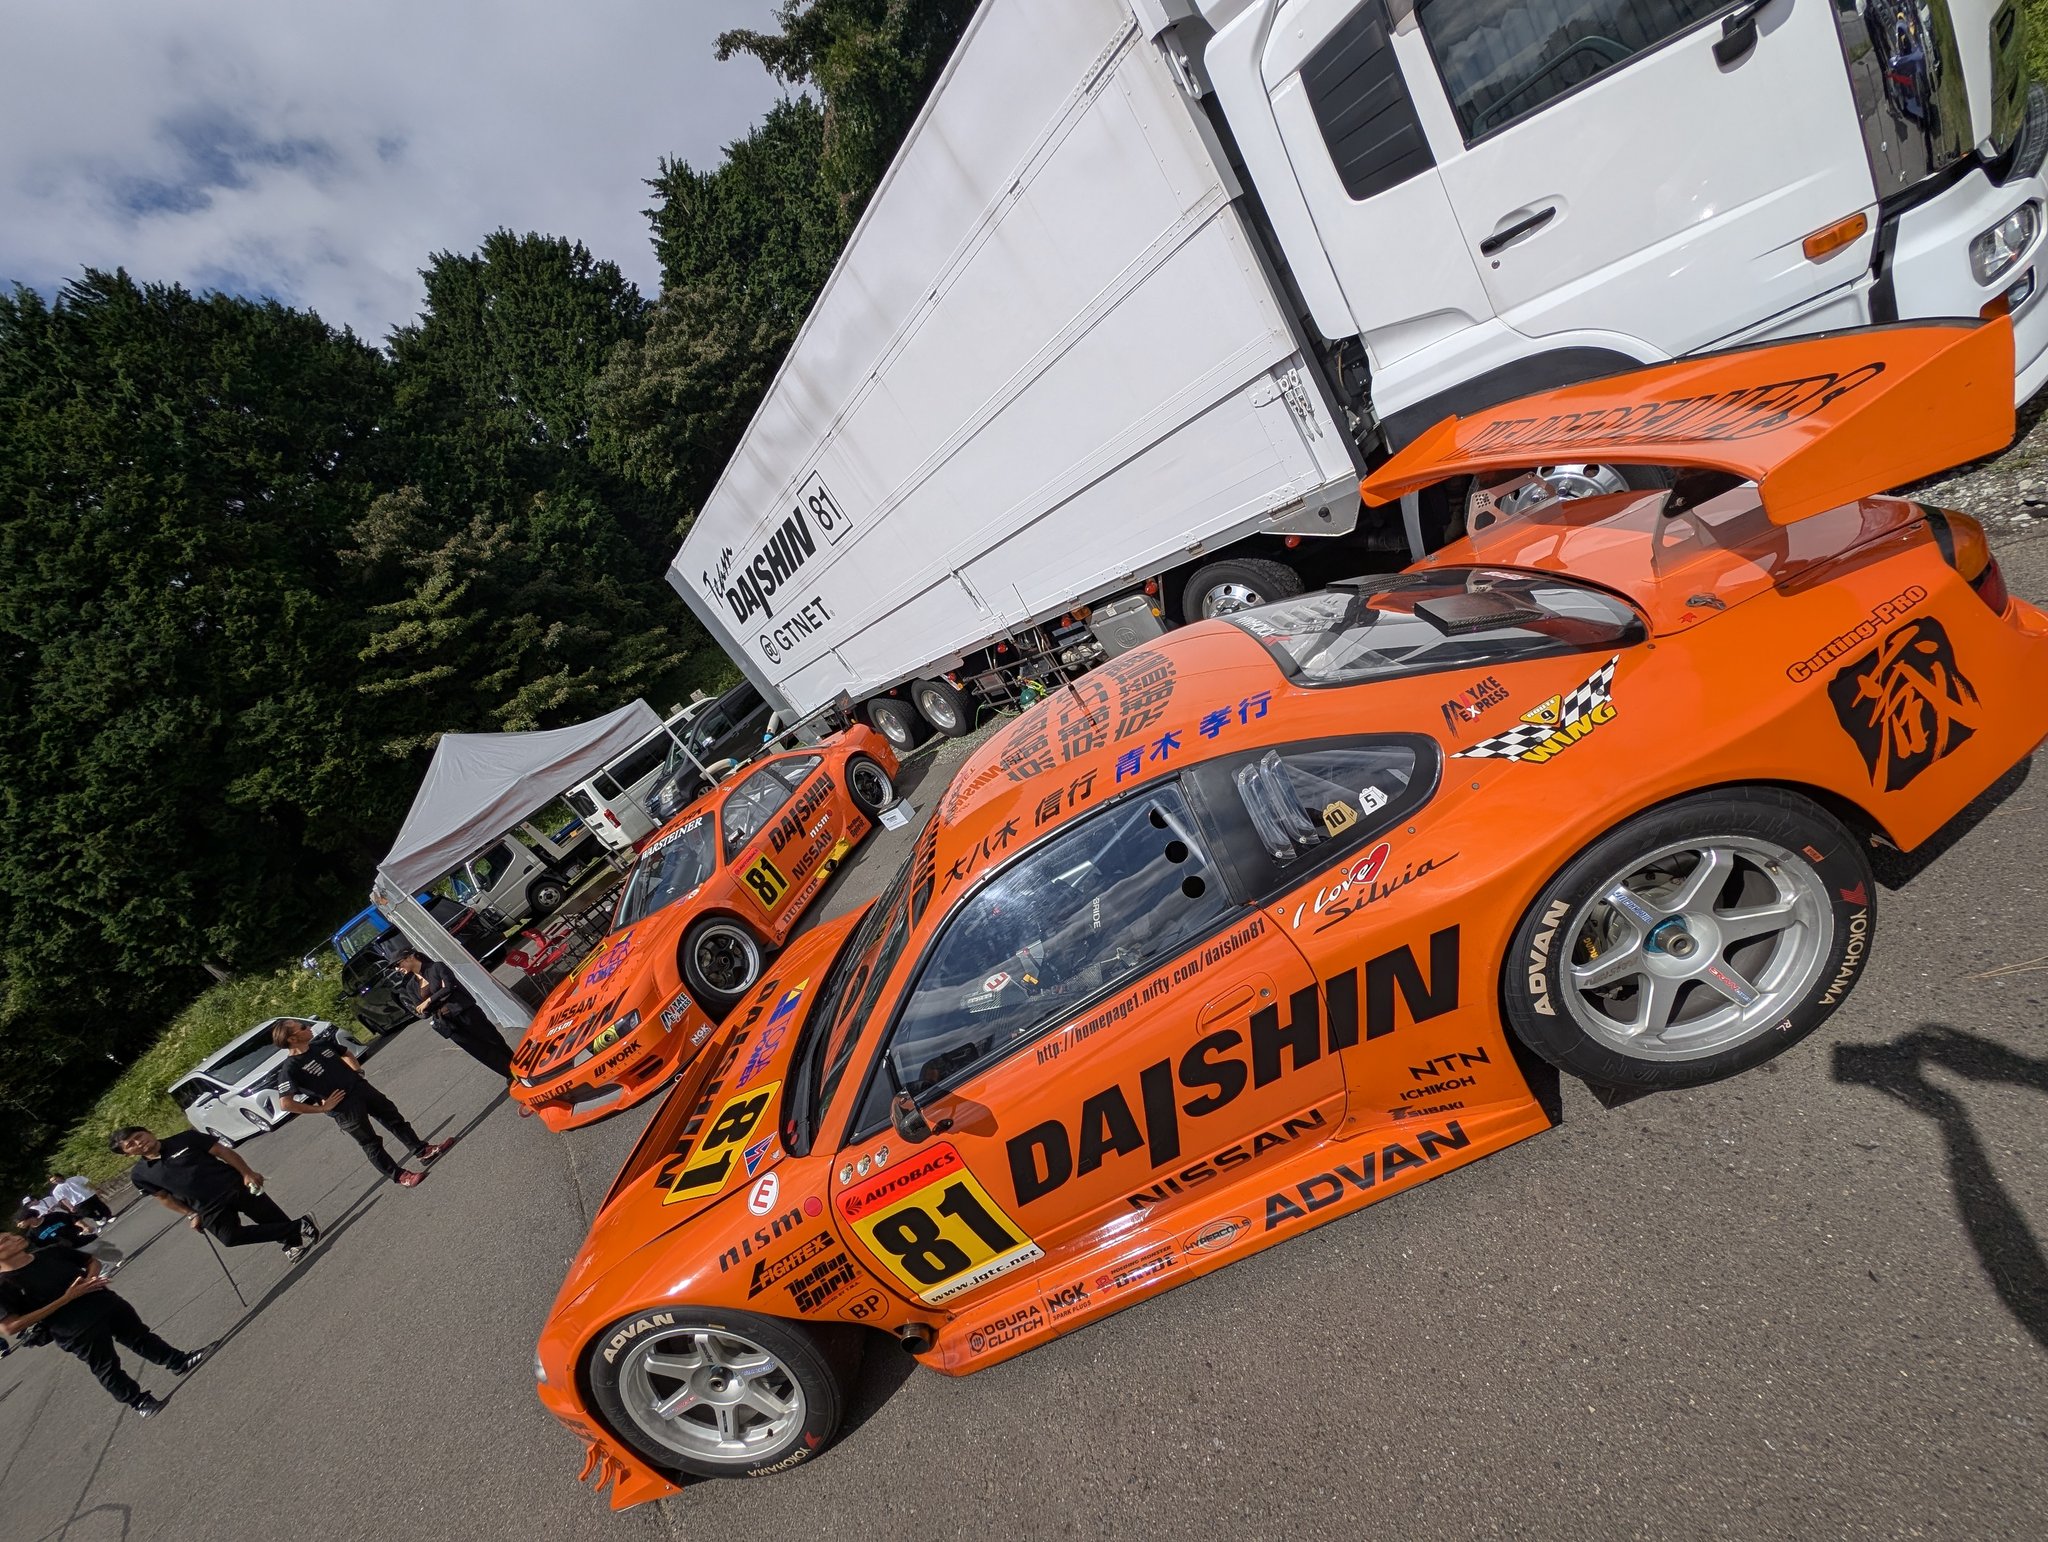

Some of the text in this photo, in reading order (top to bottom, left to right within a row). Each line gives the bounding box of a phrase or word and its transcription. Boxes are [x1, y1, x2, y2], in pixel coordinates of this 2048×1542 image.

[808, 486, 842, 531] 81
[726, 505, 817, 625] DAISHIN
[773, 595, 830, 651] GTNET
[1786, 585, 1928, 683] Cutting-PRO
[1459, 687, 1509, 722] EXPRESS
[1114, 689, 1273, 784] 青木 孝行
[1520, 702, 1618, 764] WING
[768, 771, 836, 855] DAISHIN
[1325, 809, 1346, 829] 10
[1364, 793, 1377, 809] 5
[641, 816, 703, 860] WARSTEINER
[791, 829, 833, 881] NISSAN
[941, 815, 1022, 895] 大八木
[1034, 767, 1098, 829] 信行
[745, 857, 788, 906] 81
[782, 877, 819, 924] DUNLOP
[1313, 851, 1460, 935] Silvia
[1314, 857, 1379, 913] Love
[1092, 896, 1102, 929] BRIDE
[1526, 899, 1571, 1017] ADVAN
[1817, 907, 1868, 1006] YOKOHAMA
[546, 994, 598, 1030] NISSAN
[1036, 917, 1267, 1066] http://homepage1.nifty.com/daishin81
[512, 986, 630, 1077] DAISHIN
[611, 1040, 642, 1068] WORK
[691, 1023, 711, 1043] NGK
[654, 978, 782, 1189] DAISHIN
[1005, 924, 1461, 1208] DAISHIN
[1399, 1074, 1477, 1102] ICHIKOH
[1408, 1046, 1492, 1082] NTN
[528, 1079, 574, 1105] DUNLOP
[671, 1092, 771, 1194] 81
[1124, 1108, 1329, 1213] NISSAN
[752, 1179, 774, 1209] E
[864, 1151, 957, 1206] AUTOBACS
[1264, 1120, 1473, 1232] ADVAN
[871, 1180, 1019, 1287] 81
[794, 1262, 855, 1314] Spirit
[930, 1247, 1039, 1303] www.jgtc.net
[1046, 1281, 1090, 1314] NGK
[849, 1294, 880, 1320] BP
[983, 1304, 1042, 1336] OGURA
[1052, 1299, 1093, 1322] SPARK PLUGS
[602, 1312, 676, 1365] ADVAN
[987, 1318, 1044, 1350] CLUTCH
[746, 1446, 812, 1477] YOKOHAMA
